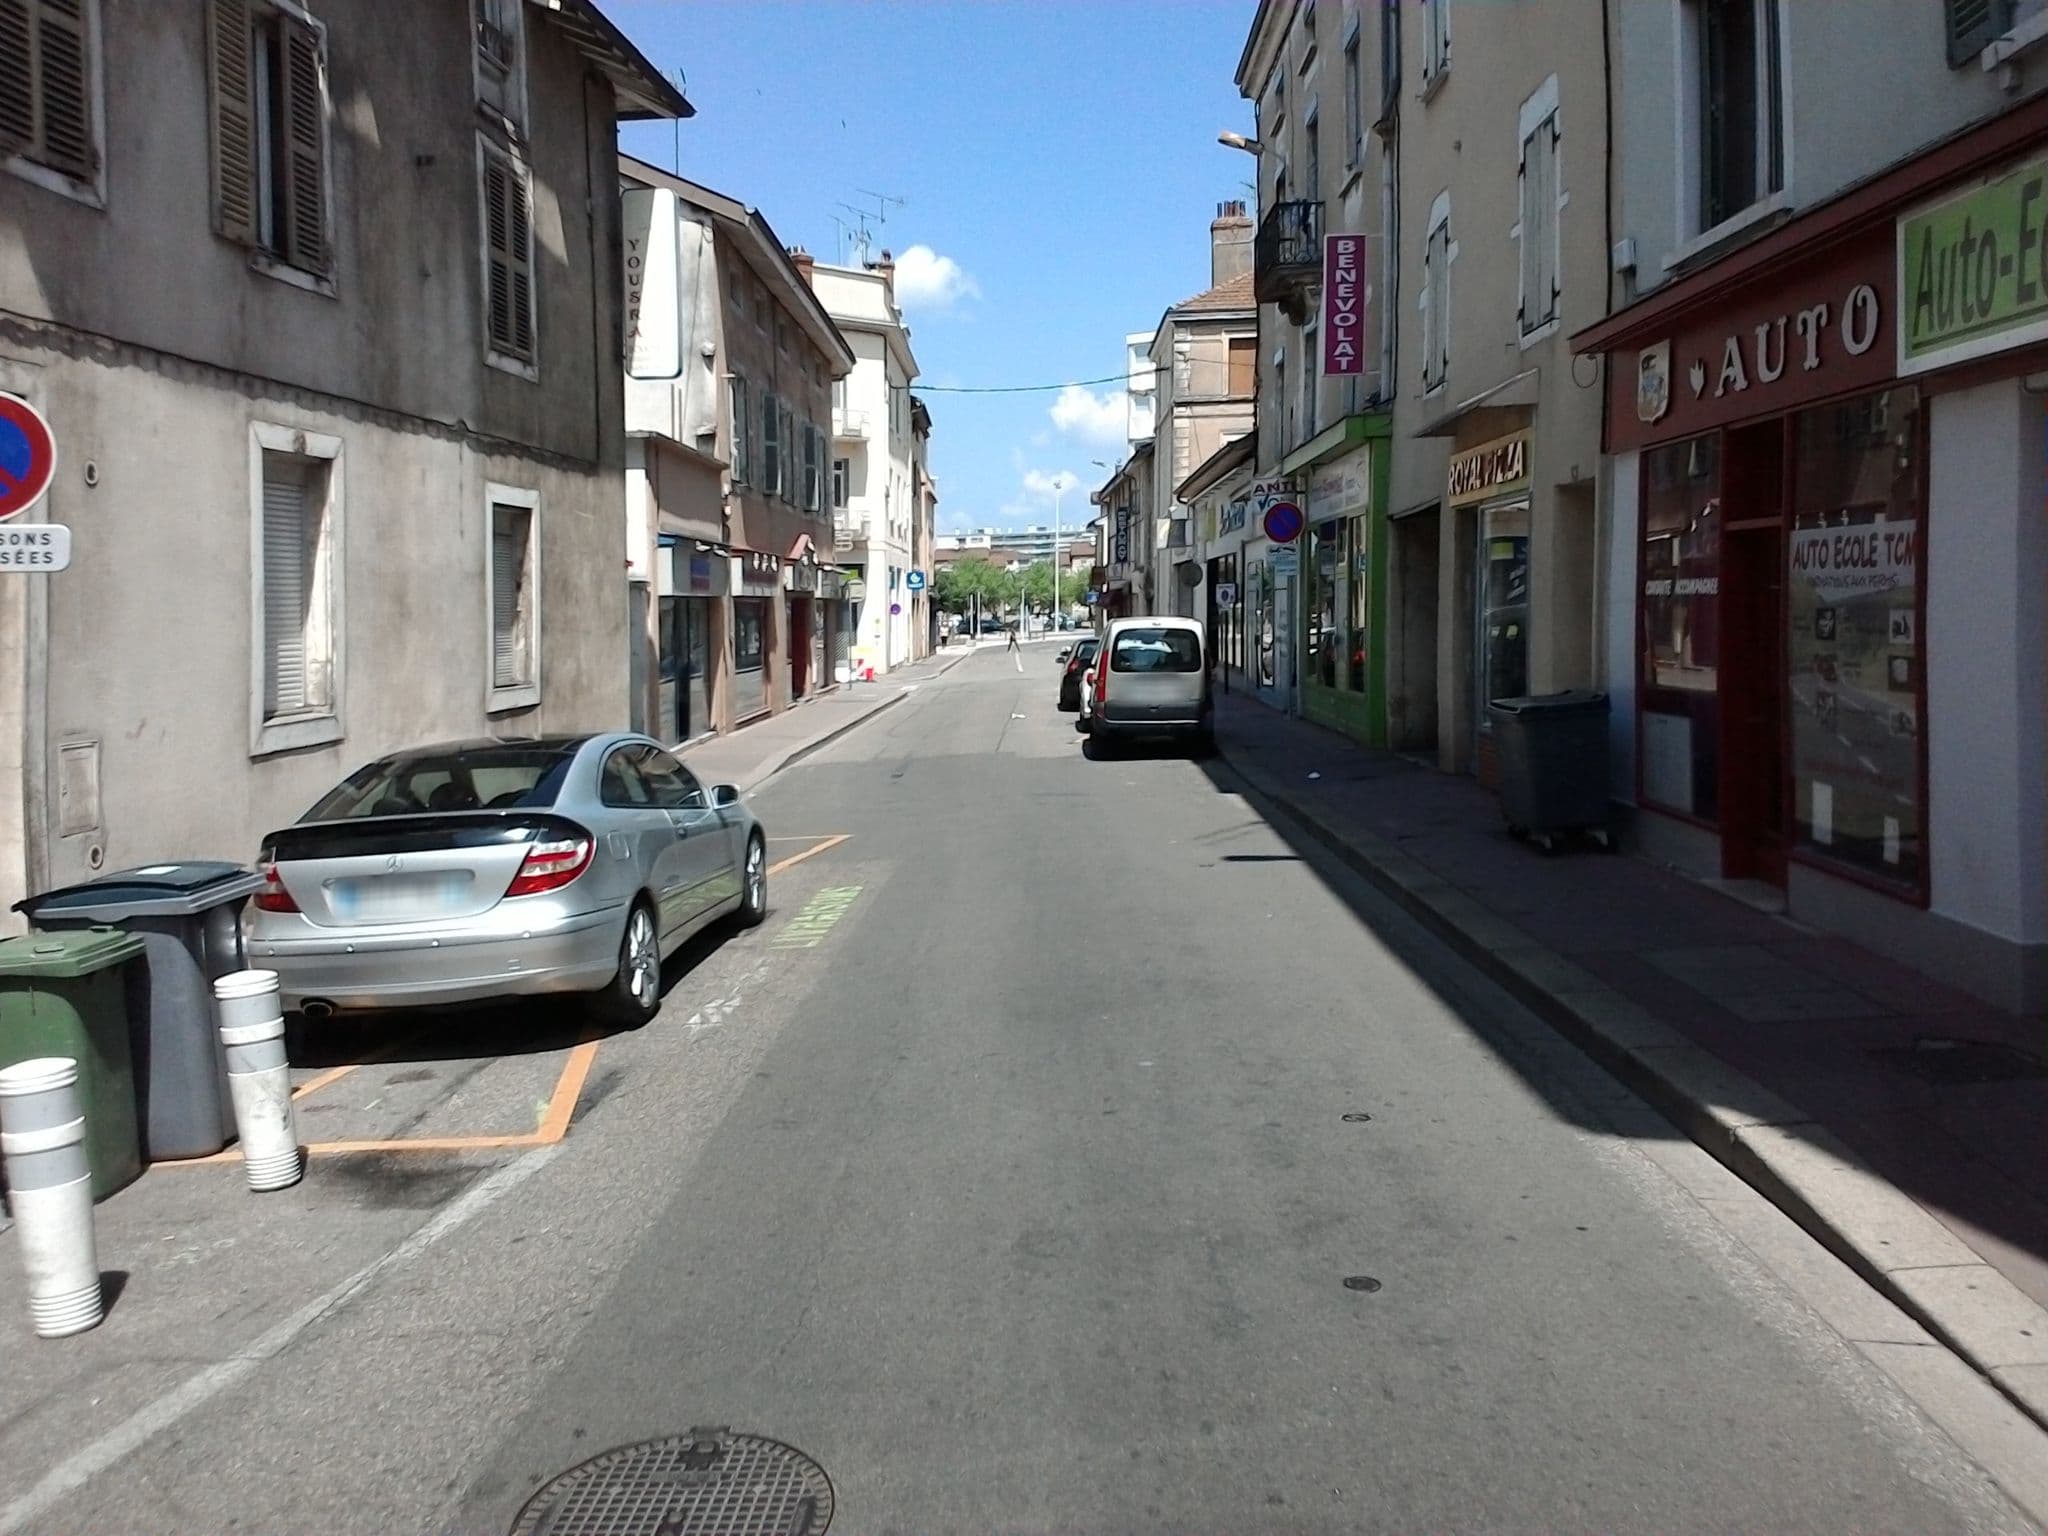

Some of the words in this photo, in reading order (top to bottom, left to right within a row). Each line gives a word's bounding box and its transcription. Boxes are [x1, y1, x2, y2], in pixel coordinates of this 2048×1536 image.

[628, 239, 642, 338] YOUSRA
[1333, 239, 1357, 370] BENEVOLAT
[1714, 283, 1880, 399] AUTO
[1448, 455, 1481, 496] ROYAL
[1483, 441, 1524, 487] PIZZA
[1792, 538, 1829, 570] AUTO
[1834, 532, 1879, 569] ECOLE
